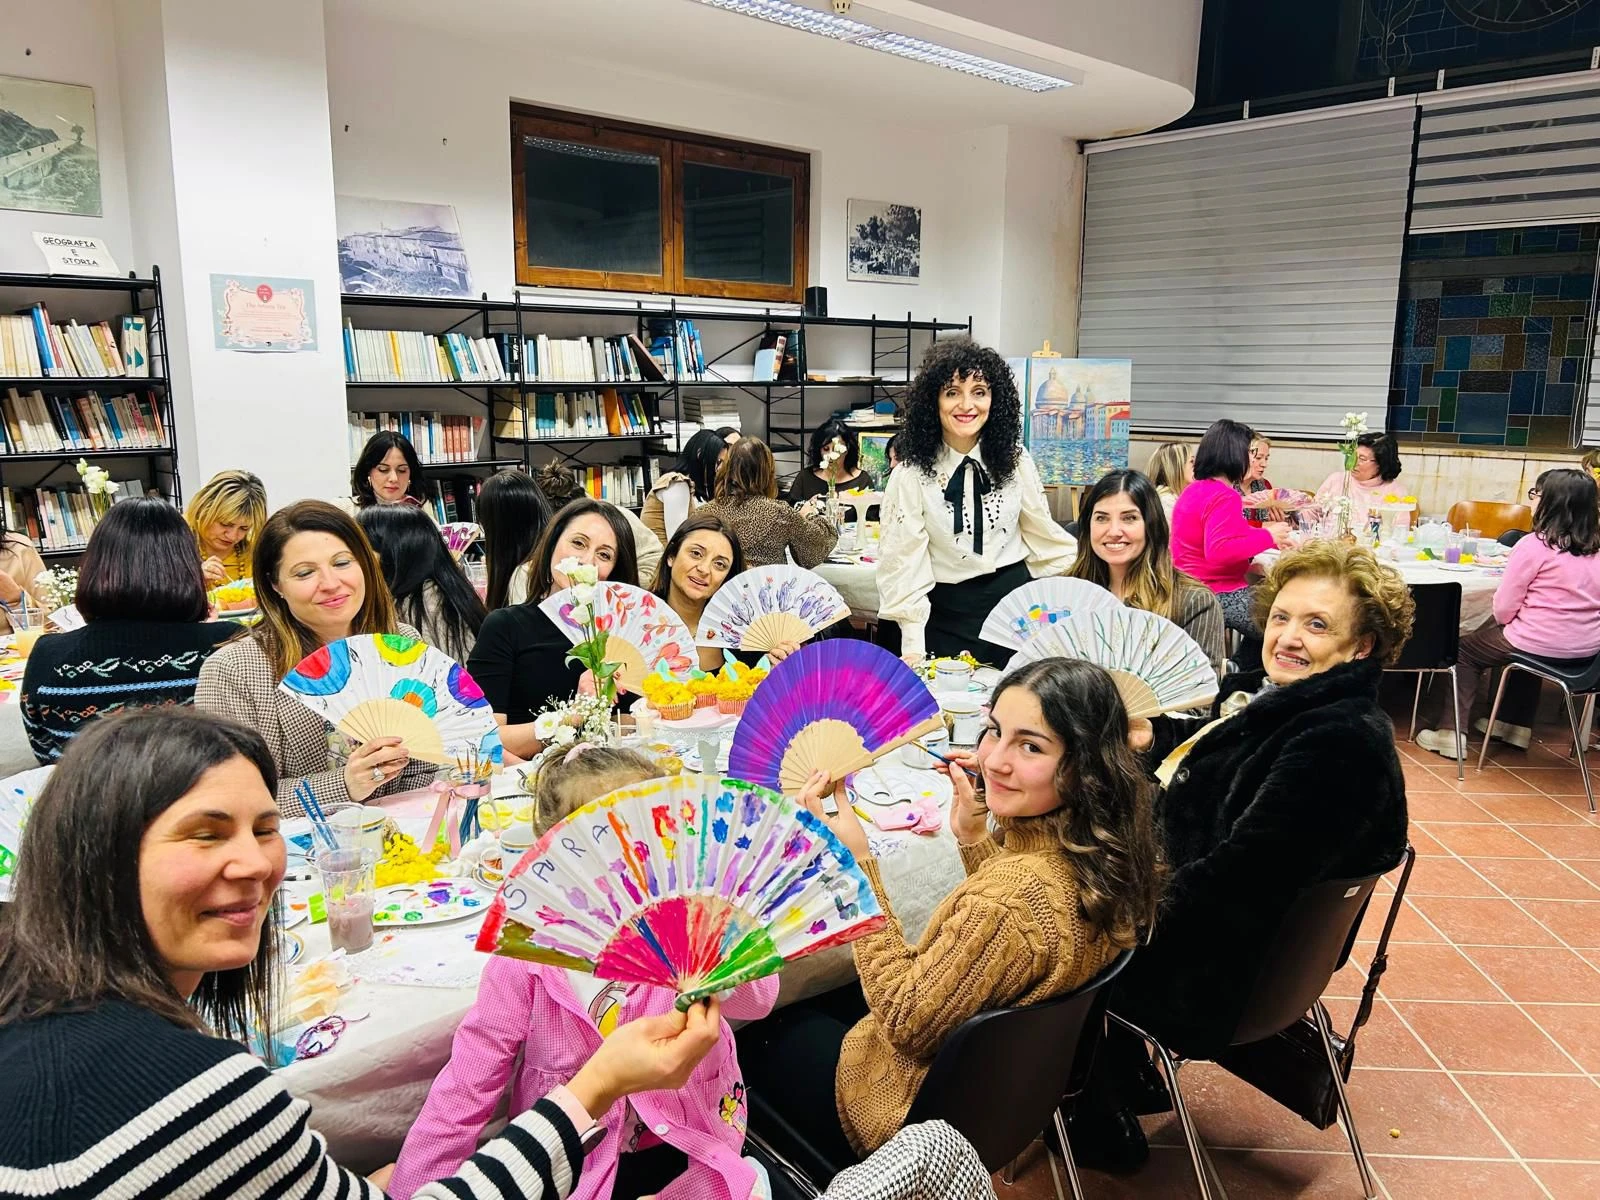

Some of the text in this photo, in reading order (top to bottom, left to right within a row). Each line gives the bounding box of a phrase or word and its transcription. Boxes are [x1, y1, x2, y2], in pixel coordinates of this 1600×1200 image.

[42, 236, 96, 248] GEOGRAFIA
[70, 248, 79, 257] E
[62, 257, 99, 267] STORIA
[503, 824, 610, 911] SARA
